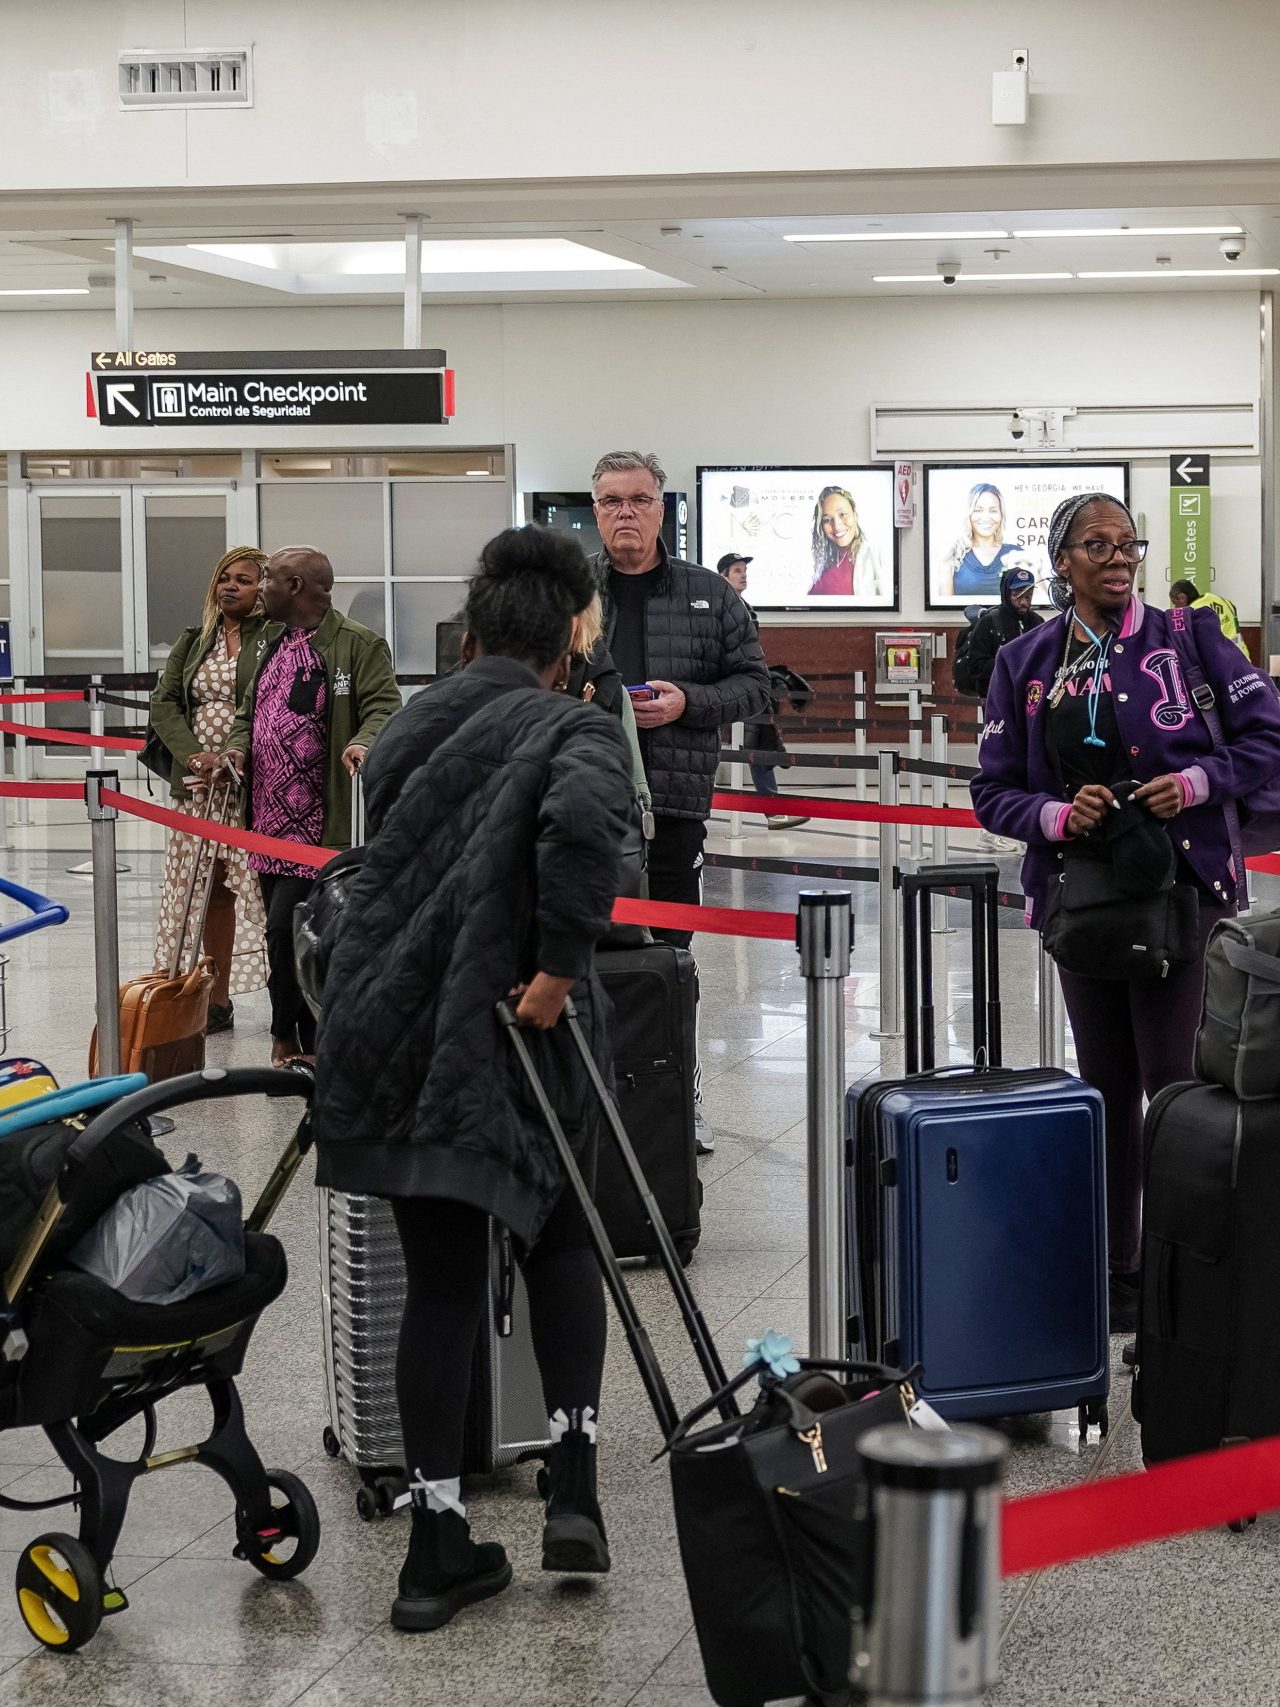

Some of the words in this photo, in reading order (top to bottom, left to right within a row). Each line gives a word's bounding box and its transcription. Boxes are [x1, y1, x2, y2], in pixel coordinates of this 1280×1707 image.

[114, 352, 132, 366] All
[135, 352, 177, 366] Gates
[188, 383, 239, 402] Main
[243, 381, 368, 406] Checkpoint
[189, 405, 230, 417] Control
[232, 405, 250, 416] de
[252, 404, 311, 419] Seguridad
[897, 465, 912, 476] AED
[1184, 520, 1197, 562] Gates
